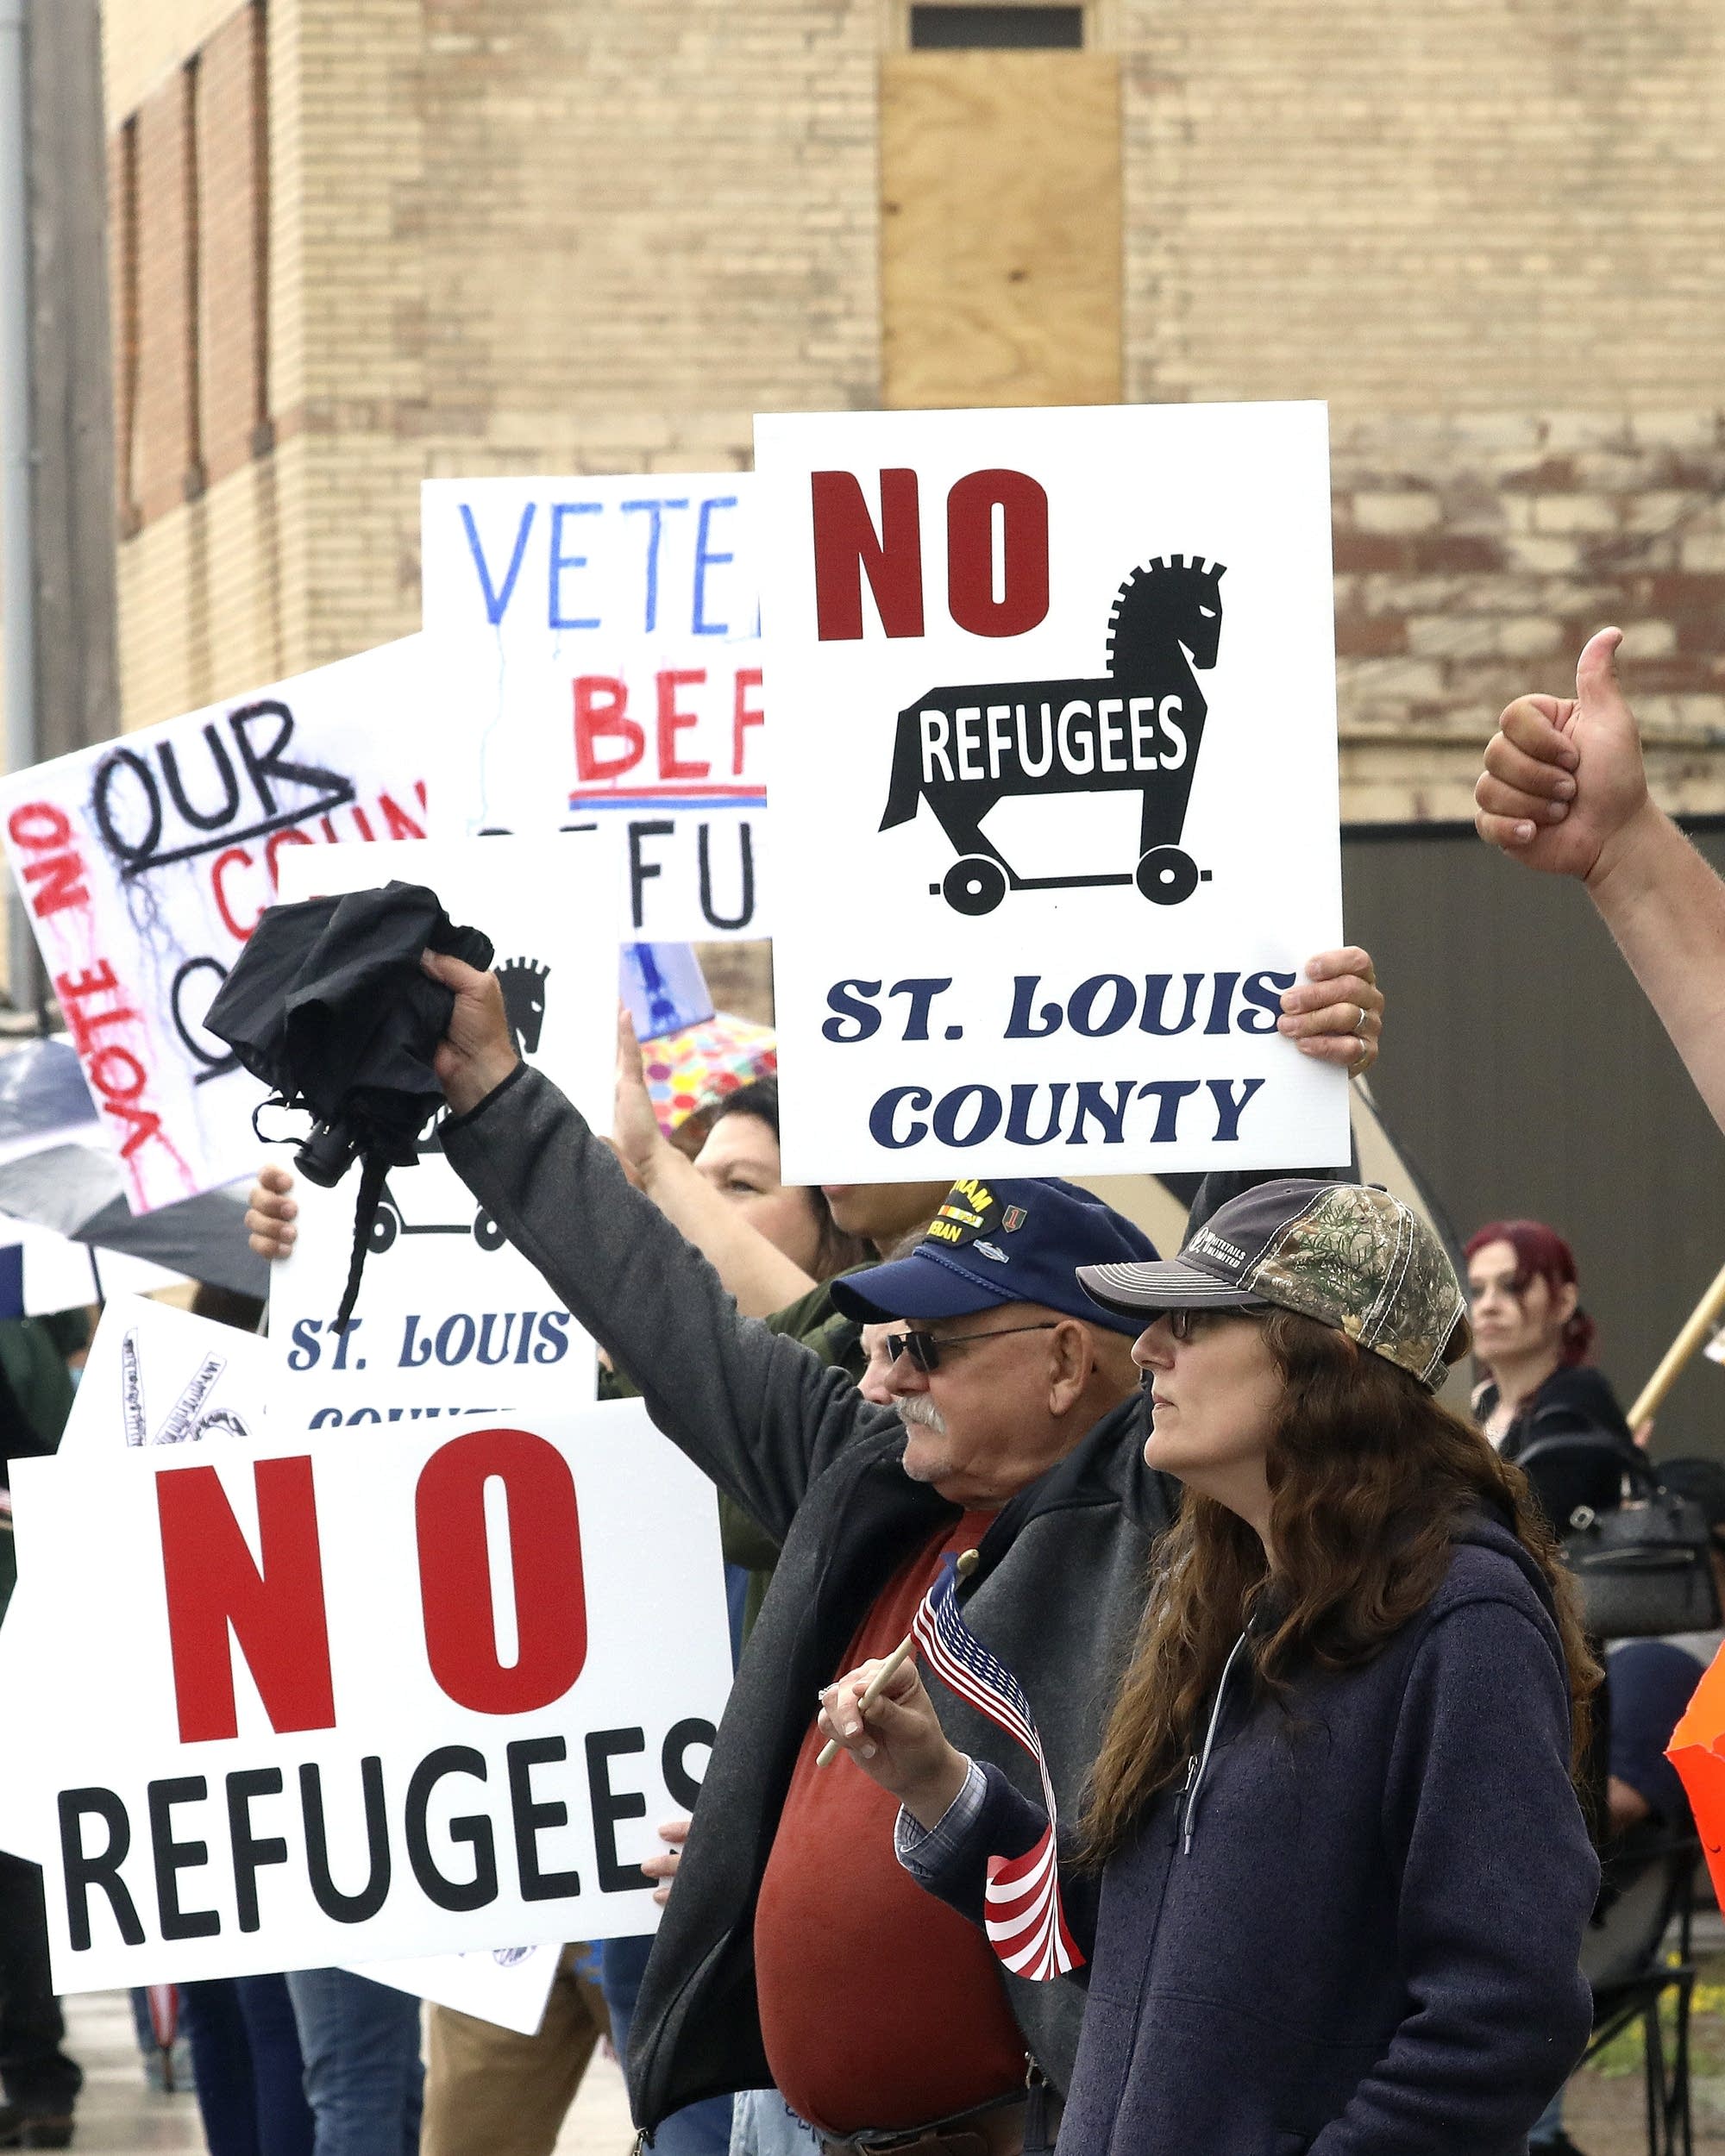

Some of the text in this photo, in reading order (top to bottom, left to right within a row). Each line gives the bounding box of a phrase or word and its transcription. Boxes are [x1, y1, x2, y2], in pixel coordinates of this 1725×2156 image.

[460, 497, 761, 636] VETE
[813, 468, 1049, 640] NO
[919, 694, 1188, 783] REFUGEES
[93, 700, 354, 862] OUR
[9, 802, 166, 1159] VOTE NO
[820, 971, 1296, 1043] ST. LOUIS
[869, 1078, 1265, 1150] COUNTY
[926, 1220, 963, 1243] ERAN
[950, 1179, 994, 1213] NAM
[1202, 1242, 1241, 1269] UNLIMITED
[1205, 1232, 1246, 1261] WHITETAILS
[287, 1311, 570, 1371] ST. LOUIS
[156, 1428, 587, 1743] NO
